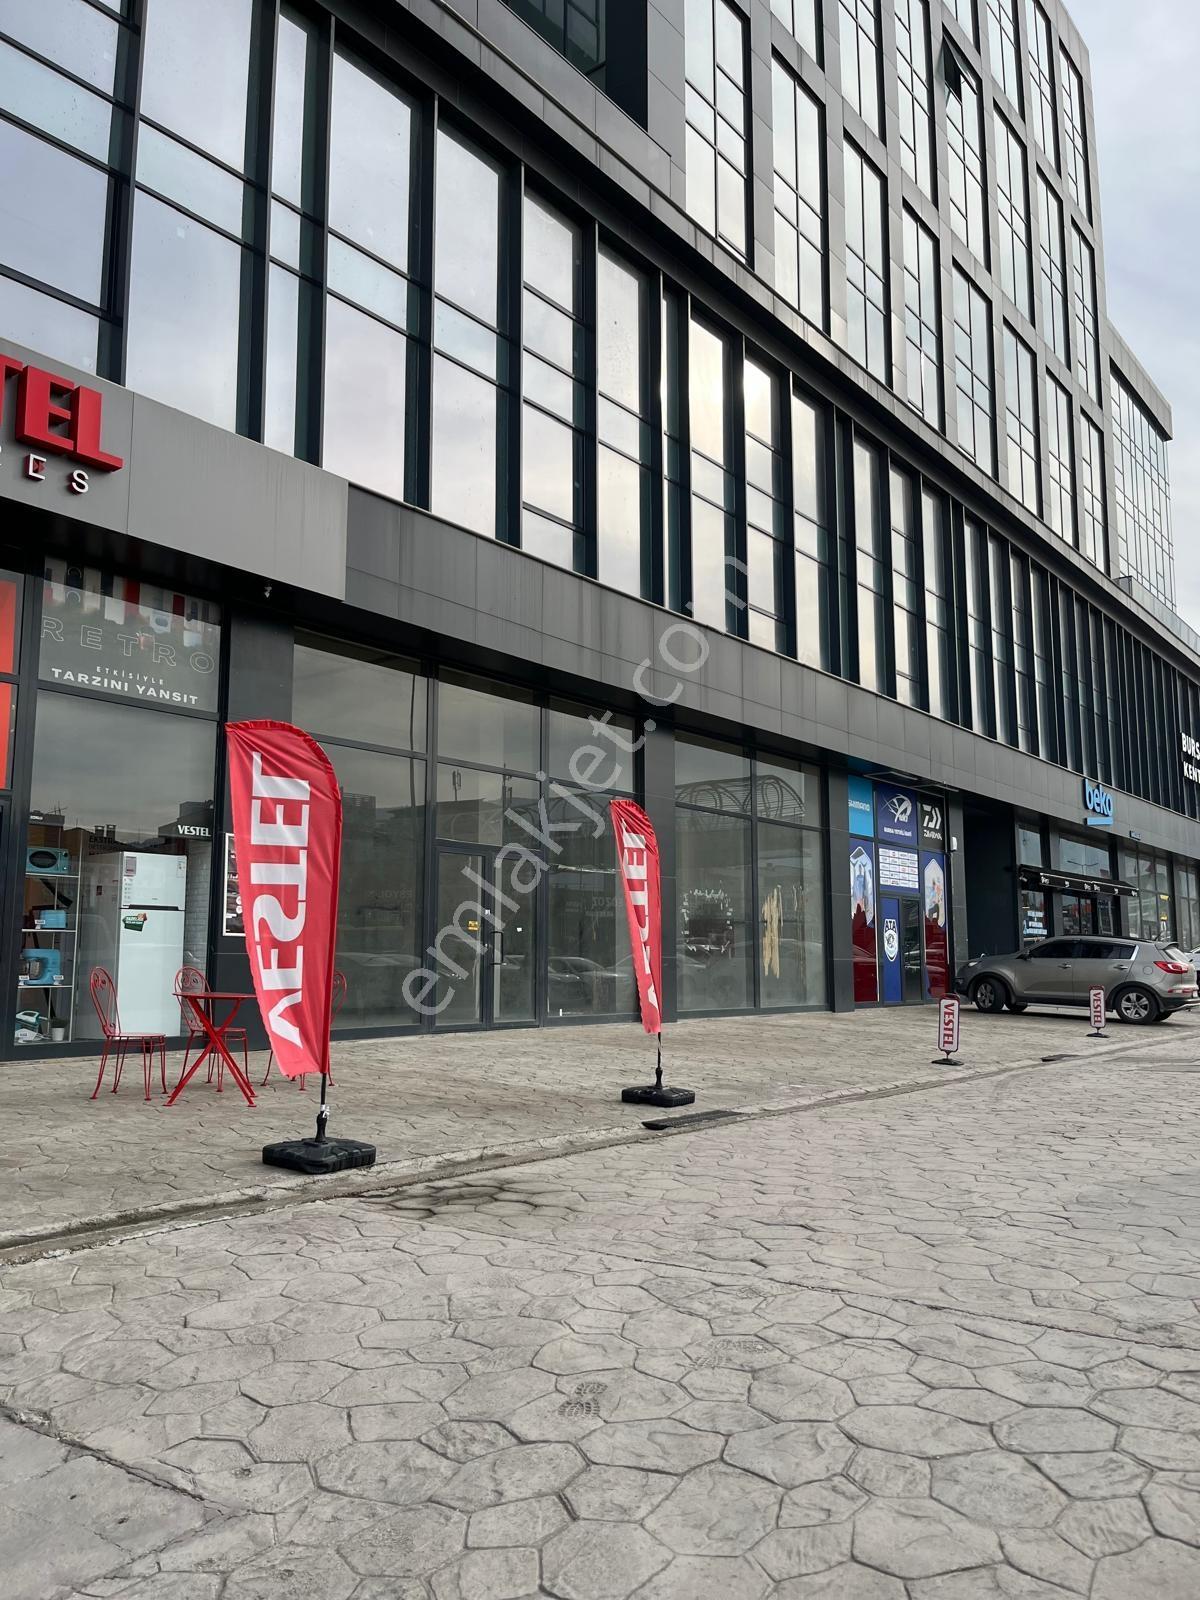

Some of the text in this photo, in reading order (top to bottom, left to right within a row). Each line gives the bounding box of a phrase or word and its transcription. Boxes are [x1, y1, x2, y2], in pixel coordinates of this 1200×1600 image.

[40, 616, 215, 674] RETRO
[51, 667, 198, 705] TARZINI YANSIT
[1084, 779, 1113, 817] beko
[178, 825, 212, 837] VESTEL
[943, 1002, 955, 1048] VESTEL
[1092, 992, 1103, 1025] VESTEL
